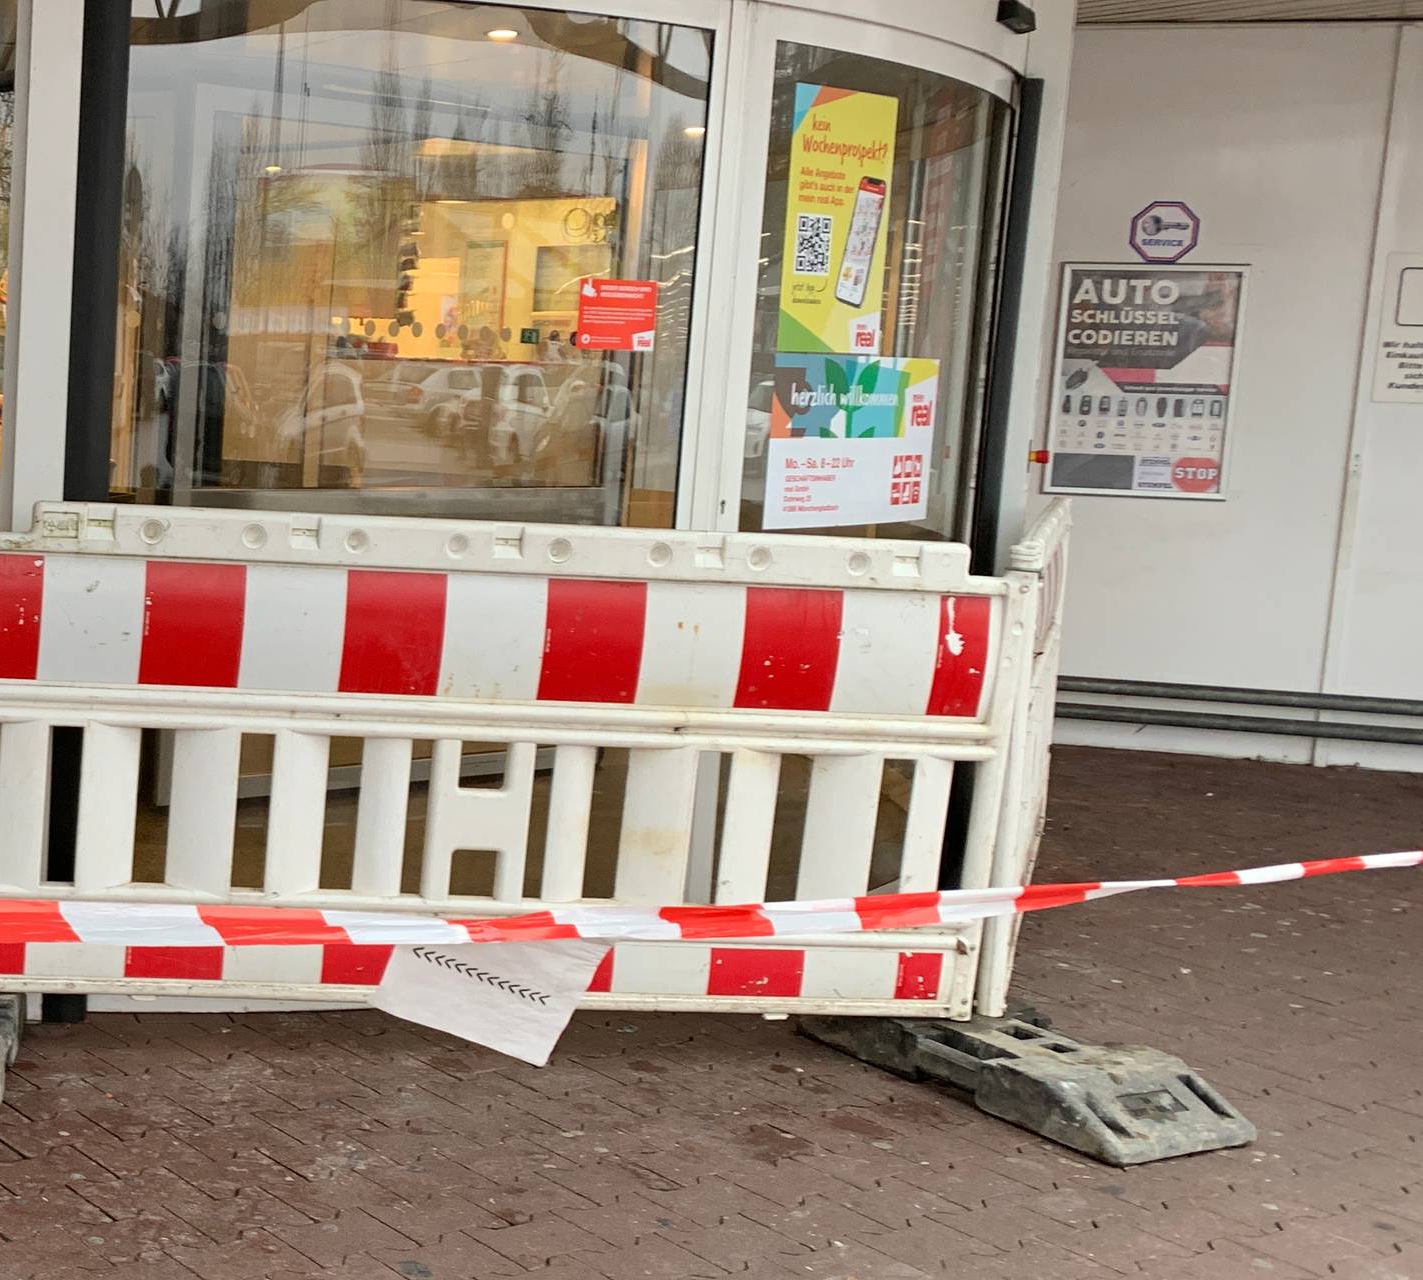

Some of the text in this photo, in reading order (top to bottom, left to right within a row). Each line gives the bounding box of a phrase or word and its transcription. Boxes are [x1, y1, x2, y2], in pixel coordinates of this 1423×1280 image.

[812, 113, 831, 132] kein
[802, 134, 888, 168] Wochenprospekt?
[1141, 238, 1183, 246] SERVICE
[1072, 278, 1180, 305] AUTO
[855, 329, 876, 347] real
[1067, 329, 1178, 346] CODIEREN
[790, 382, 898, 406] herzlich willkommen
[911, 400, 932, 427] real
[841, 456, 856, 467] Uhr
[1174, 467, 1218, 480] STOP
